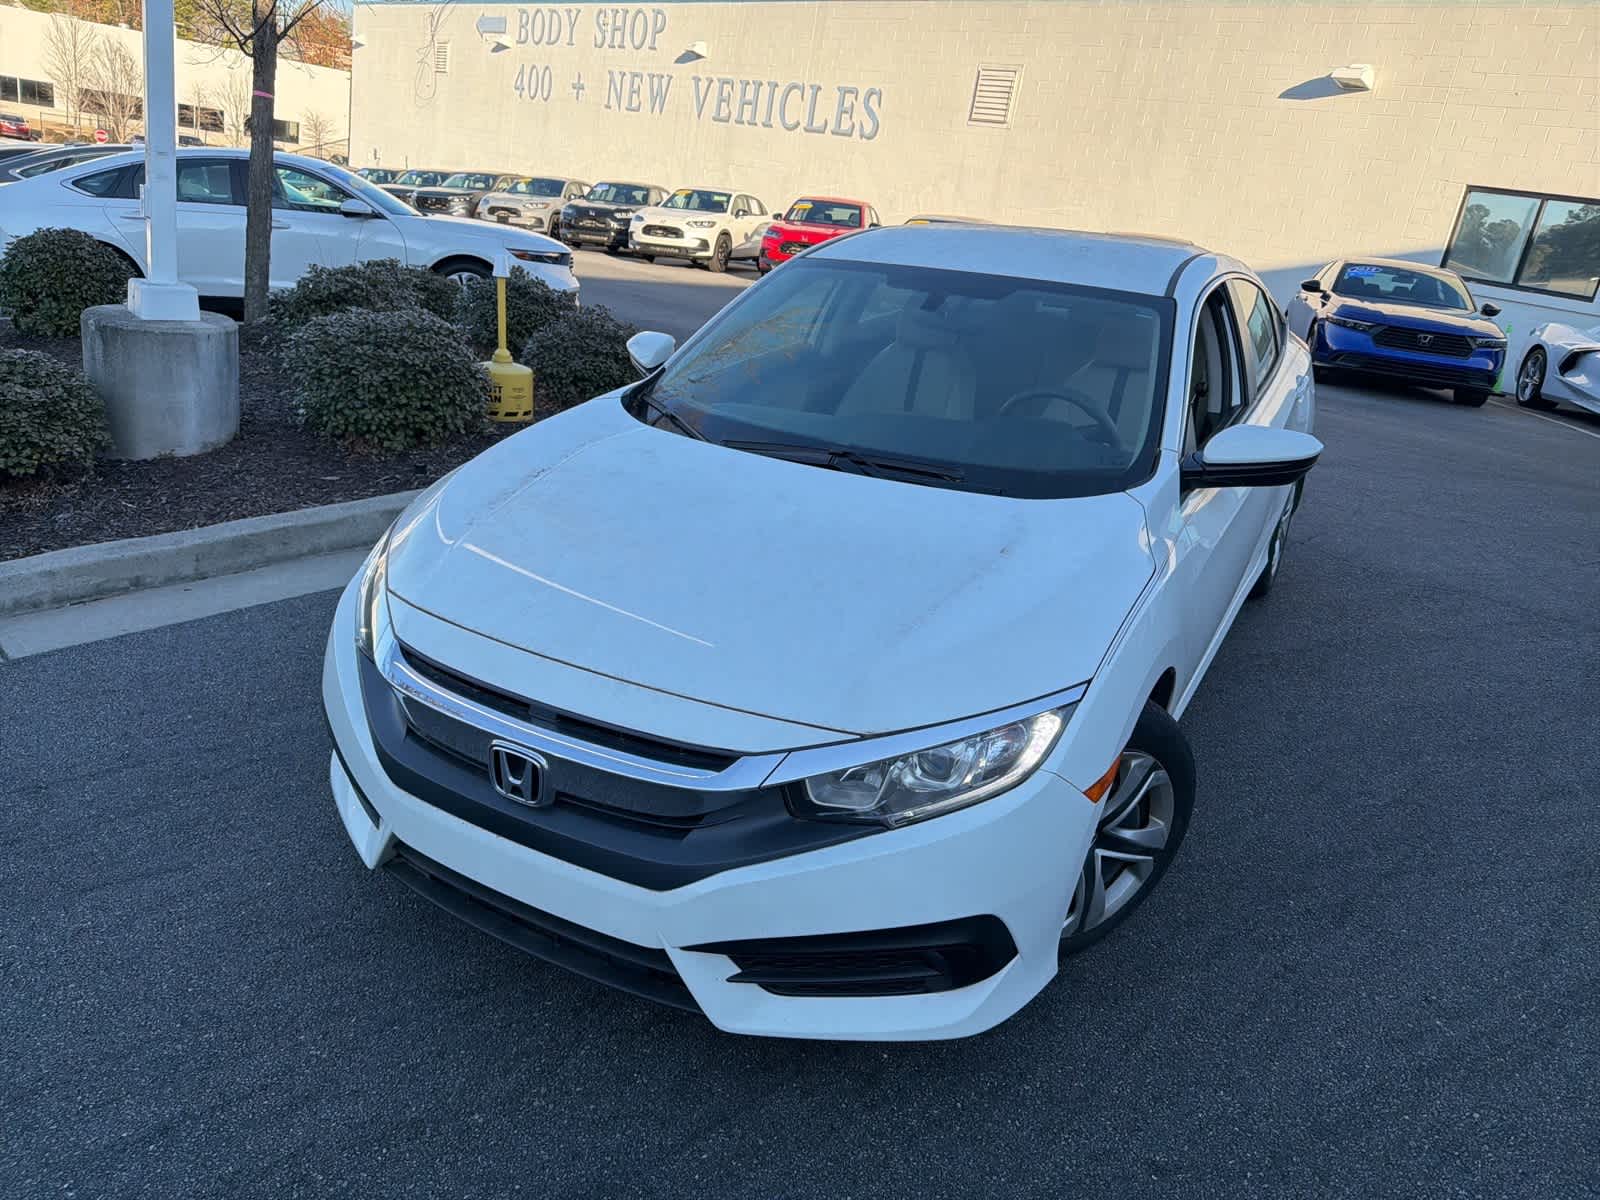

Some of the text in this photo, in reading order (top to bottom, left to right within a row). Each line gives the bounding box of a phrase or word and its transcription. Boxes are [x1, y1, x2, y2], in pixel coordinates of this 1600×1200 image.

[516, 8, 667, 50] BODY SHOP
[514, 64, 553, 102] 400
[604, 70, 674, 115] NEW
[692, 76, 881, 140] VEHICLES
